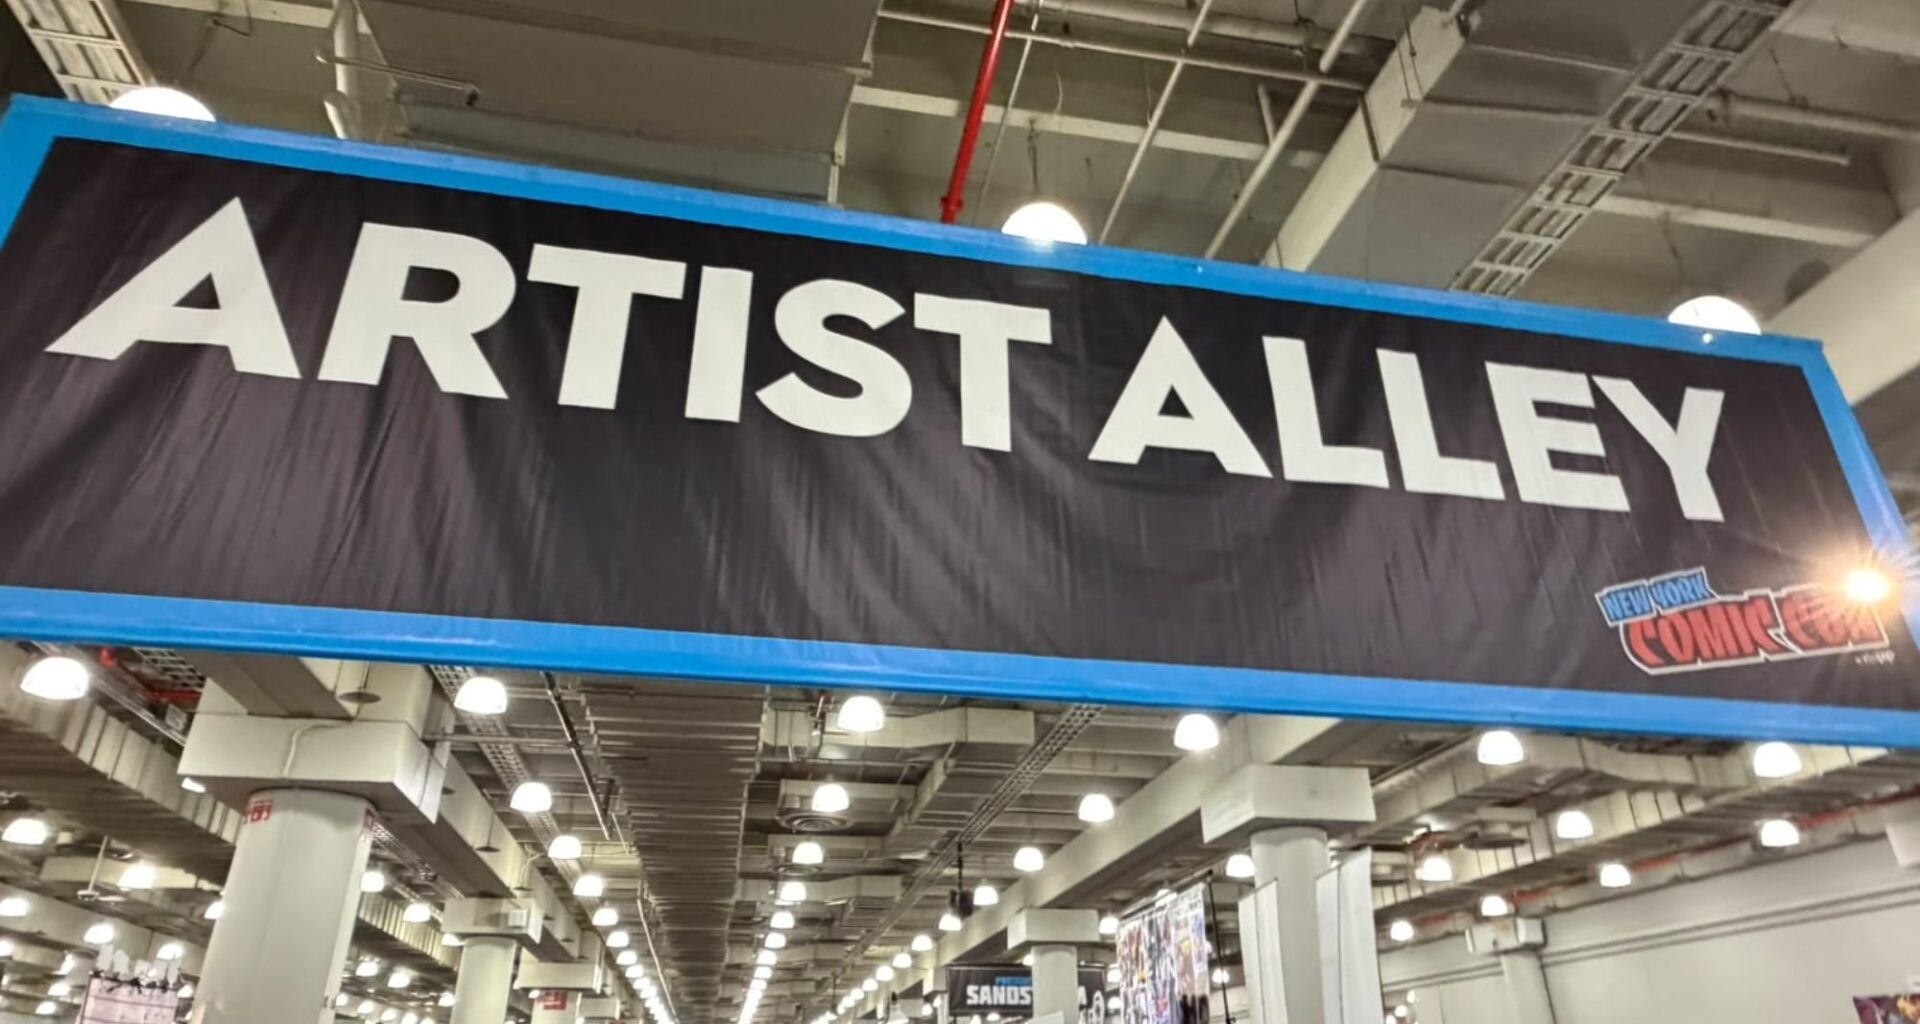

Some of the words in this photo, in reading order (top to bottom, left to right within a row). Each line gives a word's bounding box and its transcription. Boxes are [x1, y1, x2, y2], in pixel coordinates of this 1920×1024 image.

[45, 197, 1052, 453] ARTIST
[1087, 316, 1725, 522] ALLEY
[1604, 586, 1652, 618] NEW
[1651, 574, 1711, 608] YORK
[1628, 596, 1782, 666] COMIC
